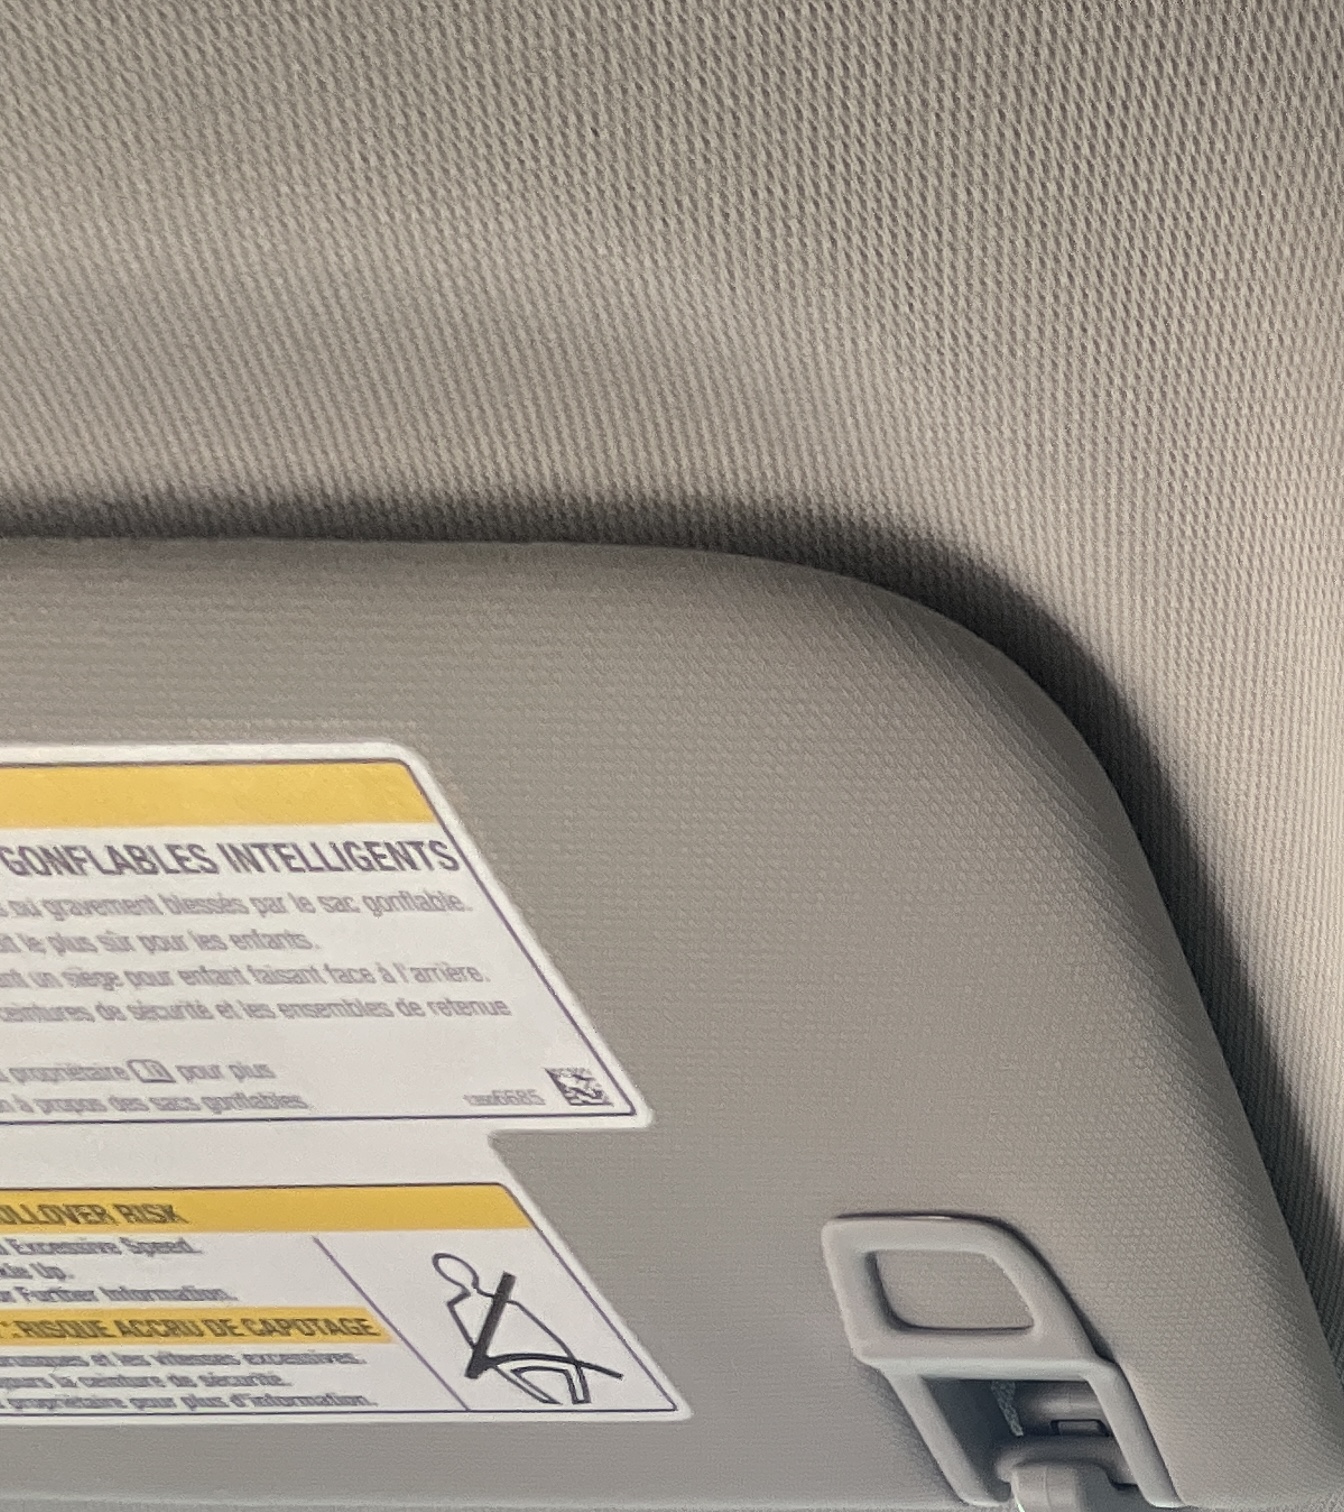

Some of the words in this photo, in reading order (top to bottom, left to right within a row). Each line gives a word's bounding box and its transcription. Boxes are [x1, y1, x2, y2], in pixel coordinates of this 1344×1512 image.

[0, 843, 219, 876] GONFLABLES
[216, 840, 461, 873] INTELLIGENTS
[42, 894, 164, 921] gravement
[249, 895, 289, 918] par
[287, 892, 316, 914] le
[317, 895, 361, 914] sac
[362, 889, 473, 919] gonflable.
[48, 932, 98, 957] plus
[136, 934, 190, 954] pour
[187, 929, 228, 951] les
[229, 928, 321, 951] enfants.
[123, 970, 174, 989] pour
[177, 965, 249, 987] enfant
[246, 964, 327, 985] faisant
[324, 962, 376, 984] face
[374, 961, 396, 983] à
[95, 1001, 127, 1021] de
[214, 1001, 242, 1019] et
[276, 998, 394, 1019] ensembles
[394, 998, 426, 1017] de
[426, 997, 511, 1016] retenue
[113, 1203, 190, 1224] RISK
[13, 1319, 117, 1338] RISQUE
[113, 1319, 205, 1338] ACCRU
[201, 1318, 245, 1337] DE
[241, 1317, 381, 1337] CAPOTAGE
